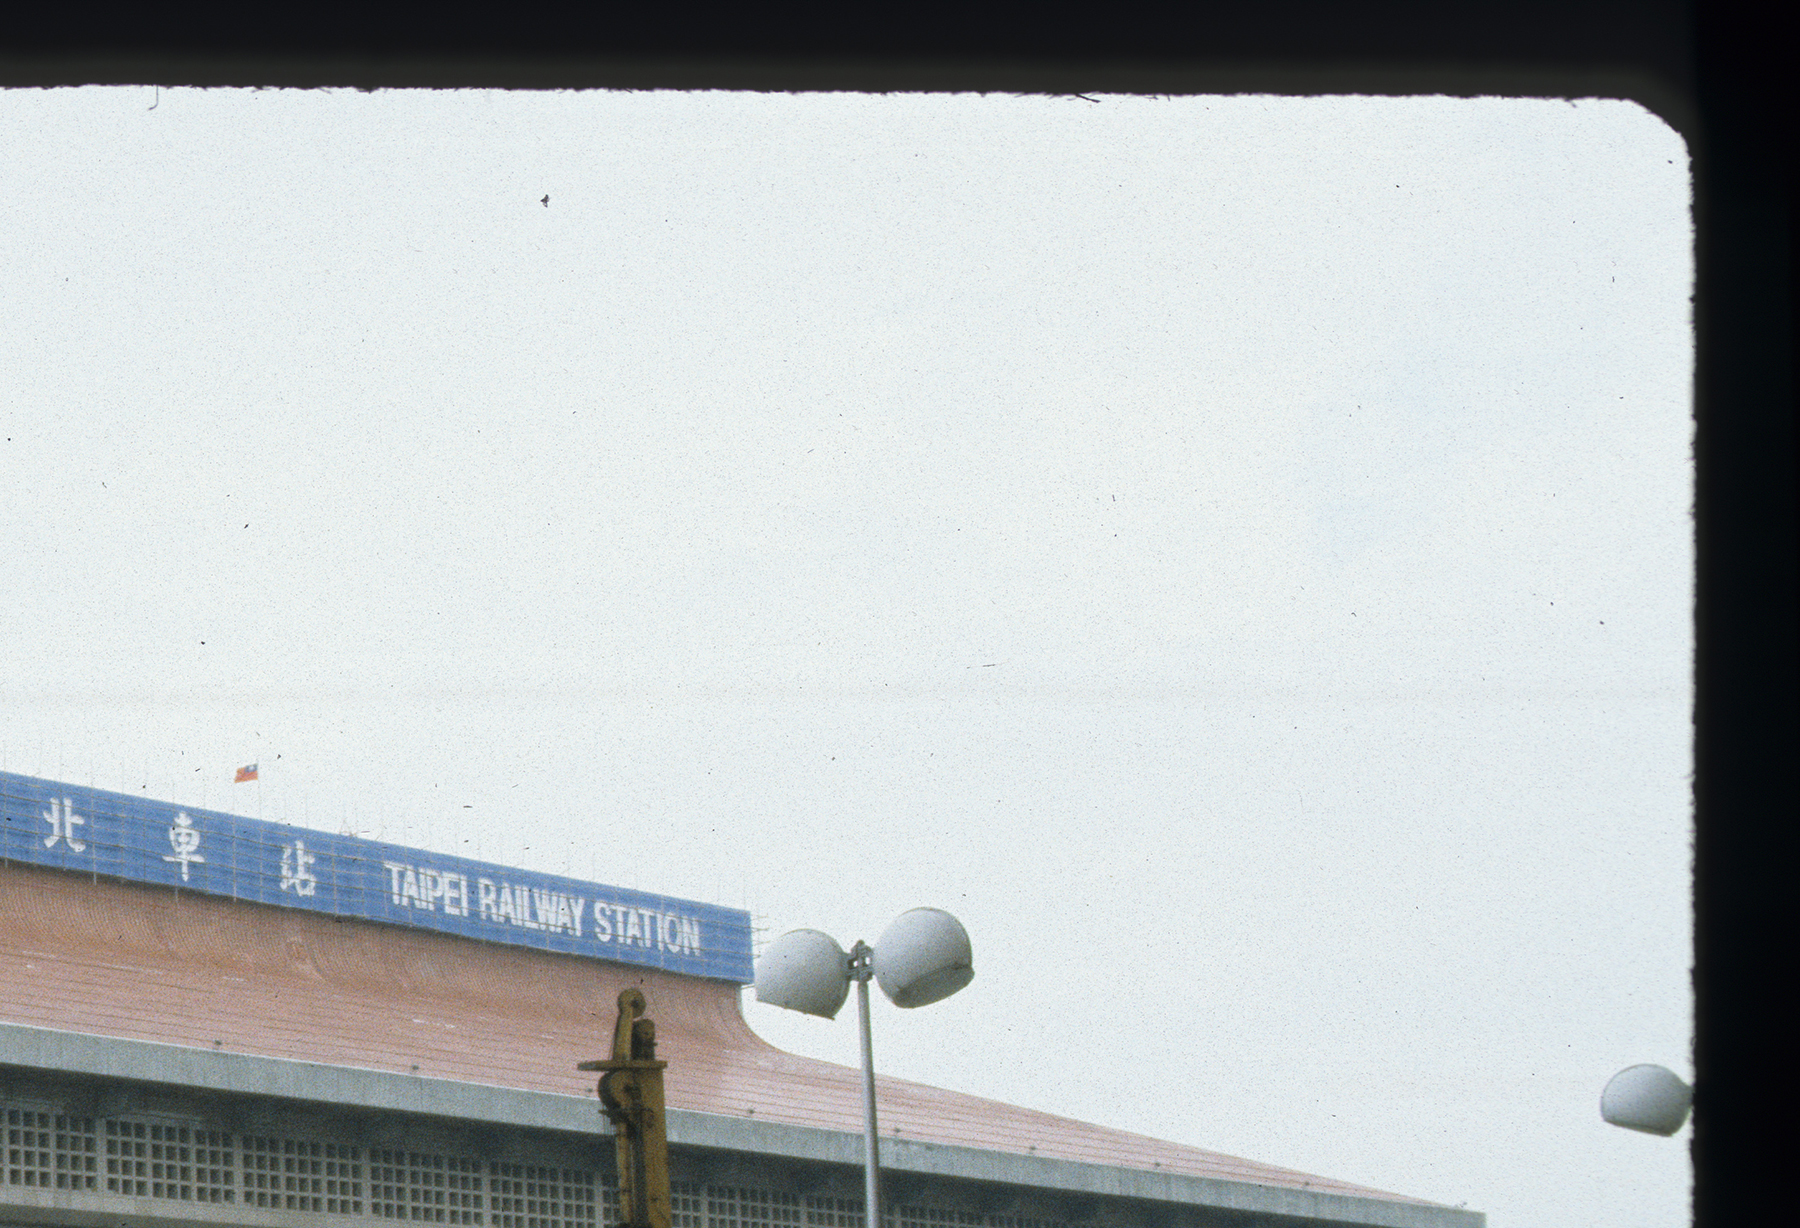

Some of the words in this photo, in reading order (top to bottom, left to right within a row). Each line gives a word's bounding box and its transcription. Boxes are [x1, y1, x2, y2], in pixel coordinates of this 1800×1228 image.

[384, 861, 470, 918] TAIPEI
[478, 878, 586, 938] RAILWAY
[593, 900, 703, 957] STATION
